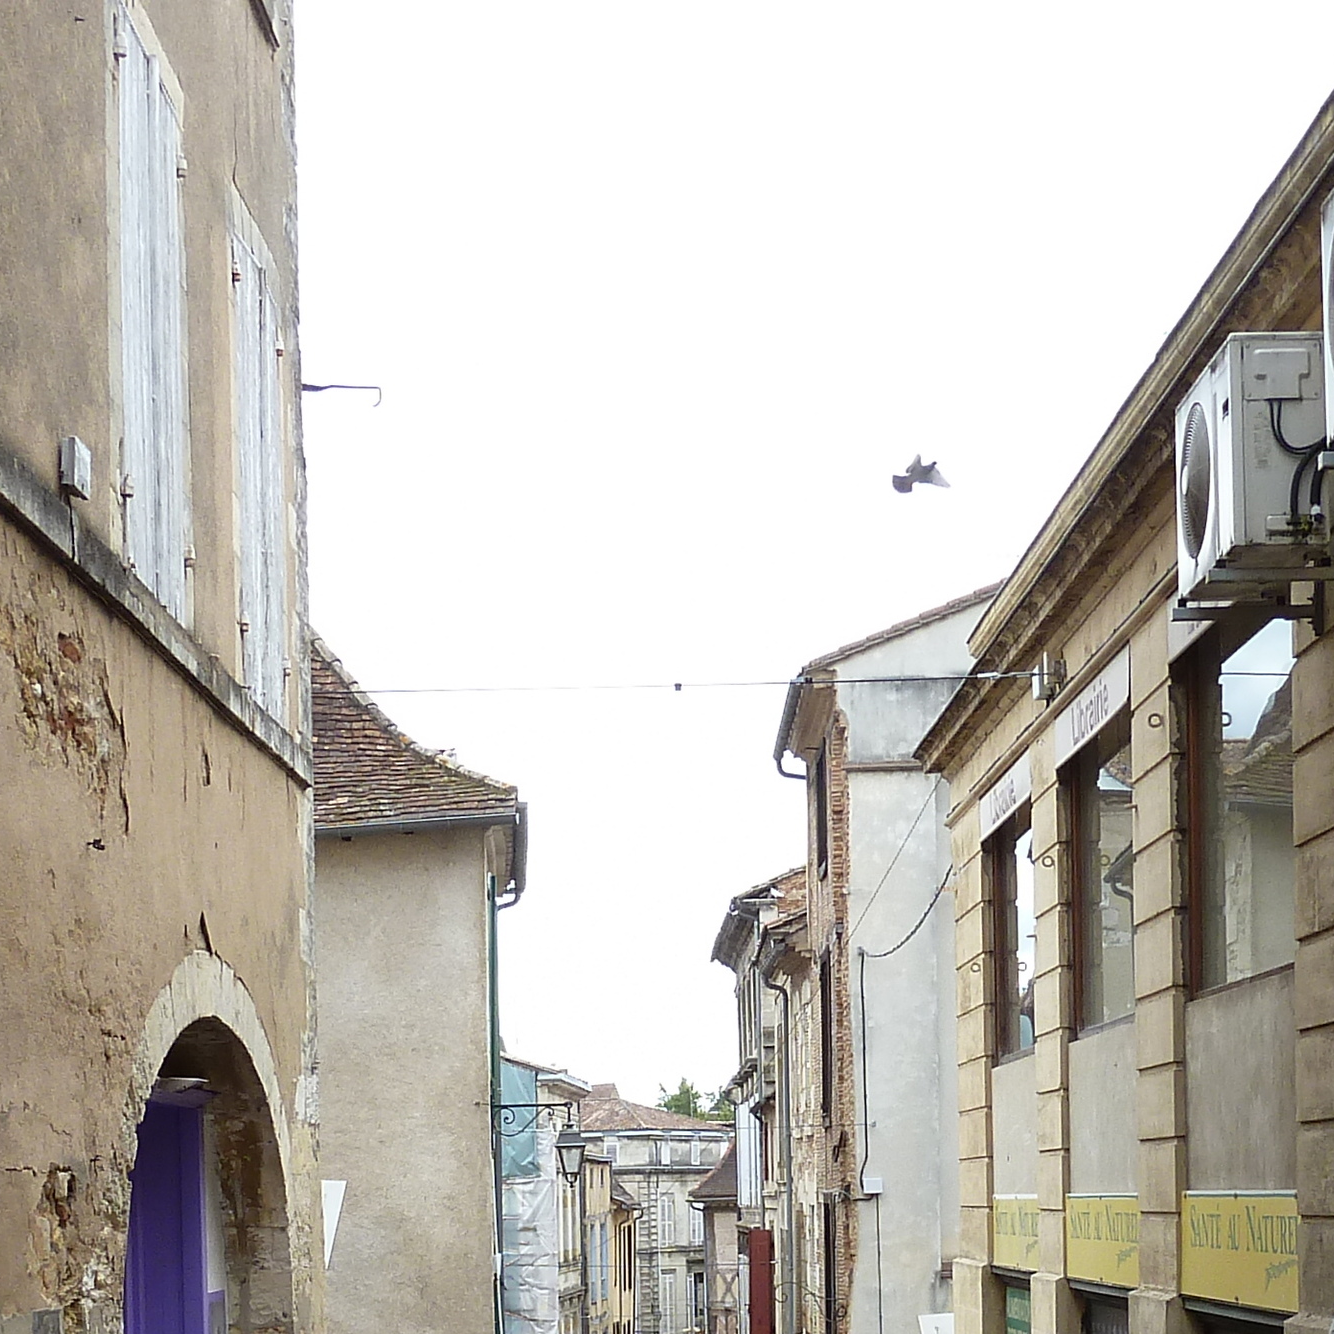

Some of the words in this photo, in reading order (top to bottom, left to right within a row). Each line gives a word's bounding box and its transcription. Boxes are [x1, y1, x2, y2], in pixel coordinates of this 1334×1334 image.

[1071, 678, 1109, 746] Librairie
[1190, 1203, 1222, 1250] SANTÉ
[1227, 1214, 1241, 1251] AU
